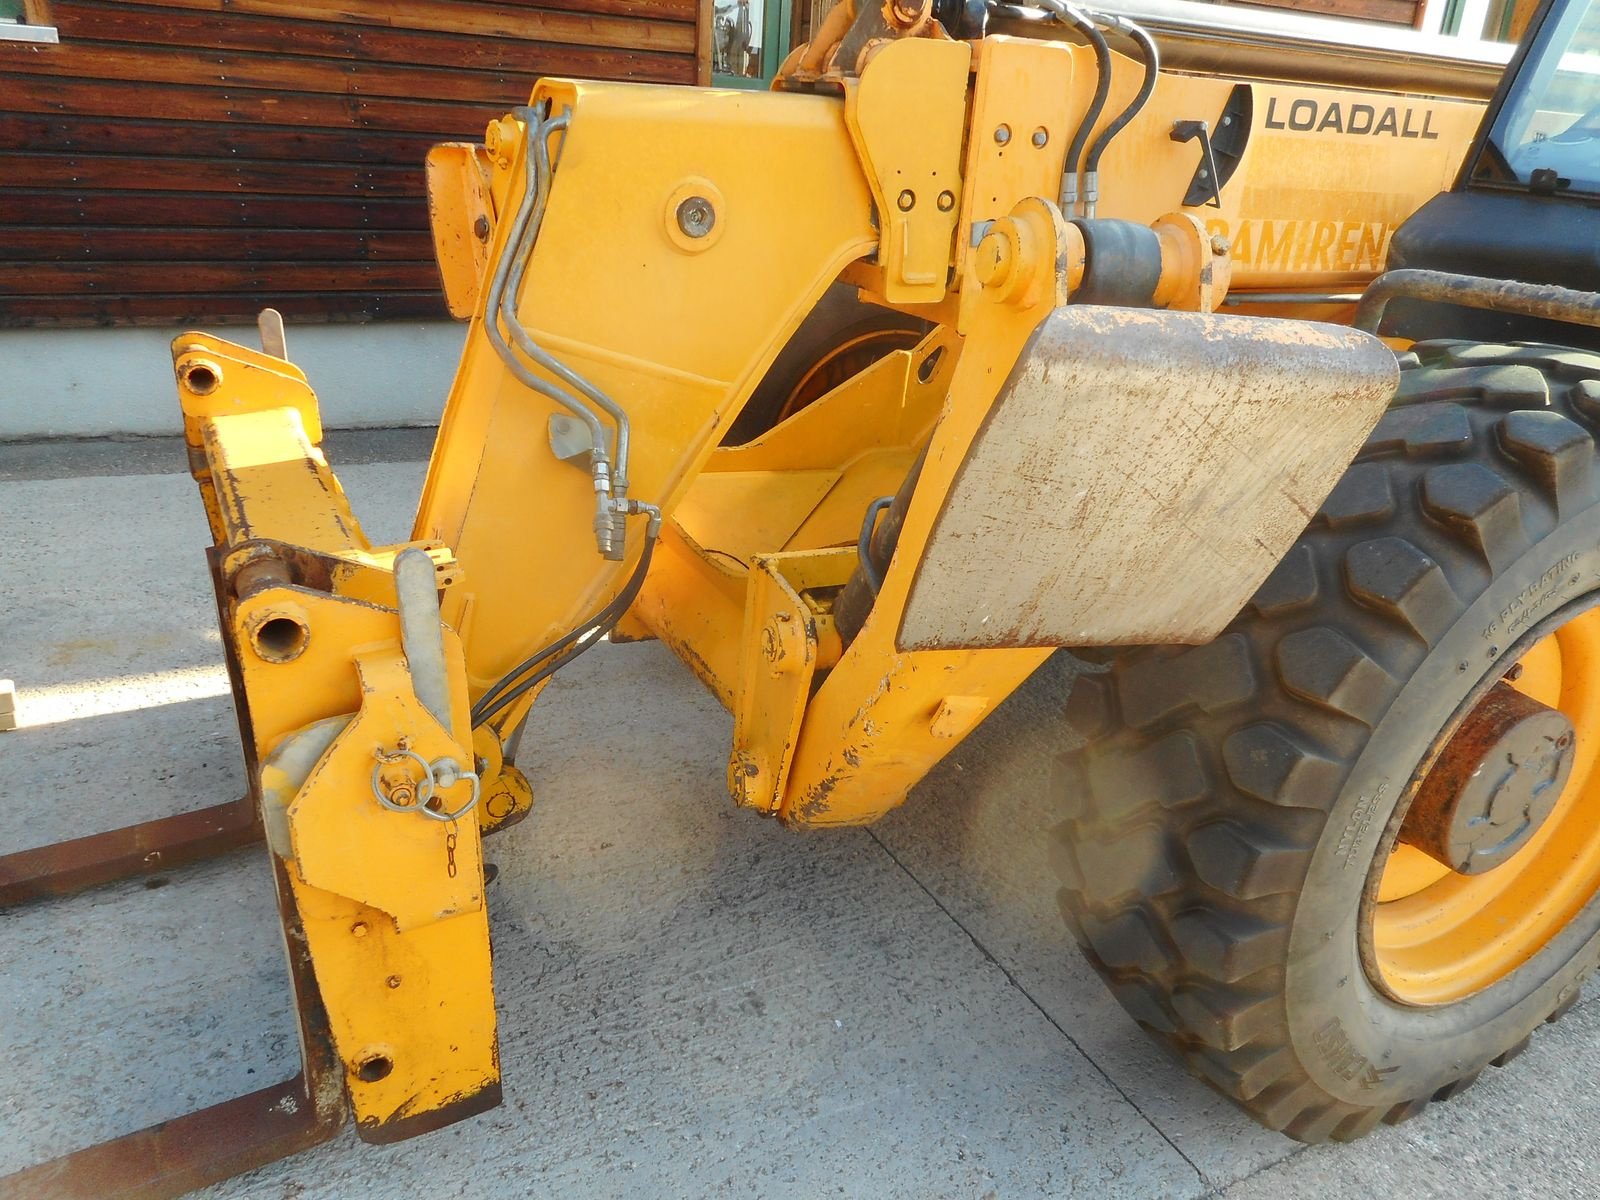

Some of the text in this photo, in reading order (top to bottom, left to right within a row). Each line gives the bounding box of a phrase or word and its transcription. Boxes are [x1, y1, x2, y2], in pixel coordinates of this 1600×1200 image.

[1264, 97, 1439, 140] LOADALL
[1206, 218, 1400, 272] AMIREN
[1499, 591, 1527, 623] PLY
[1334, 796, 1369, 856] NYLON
